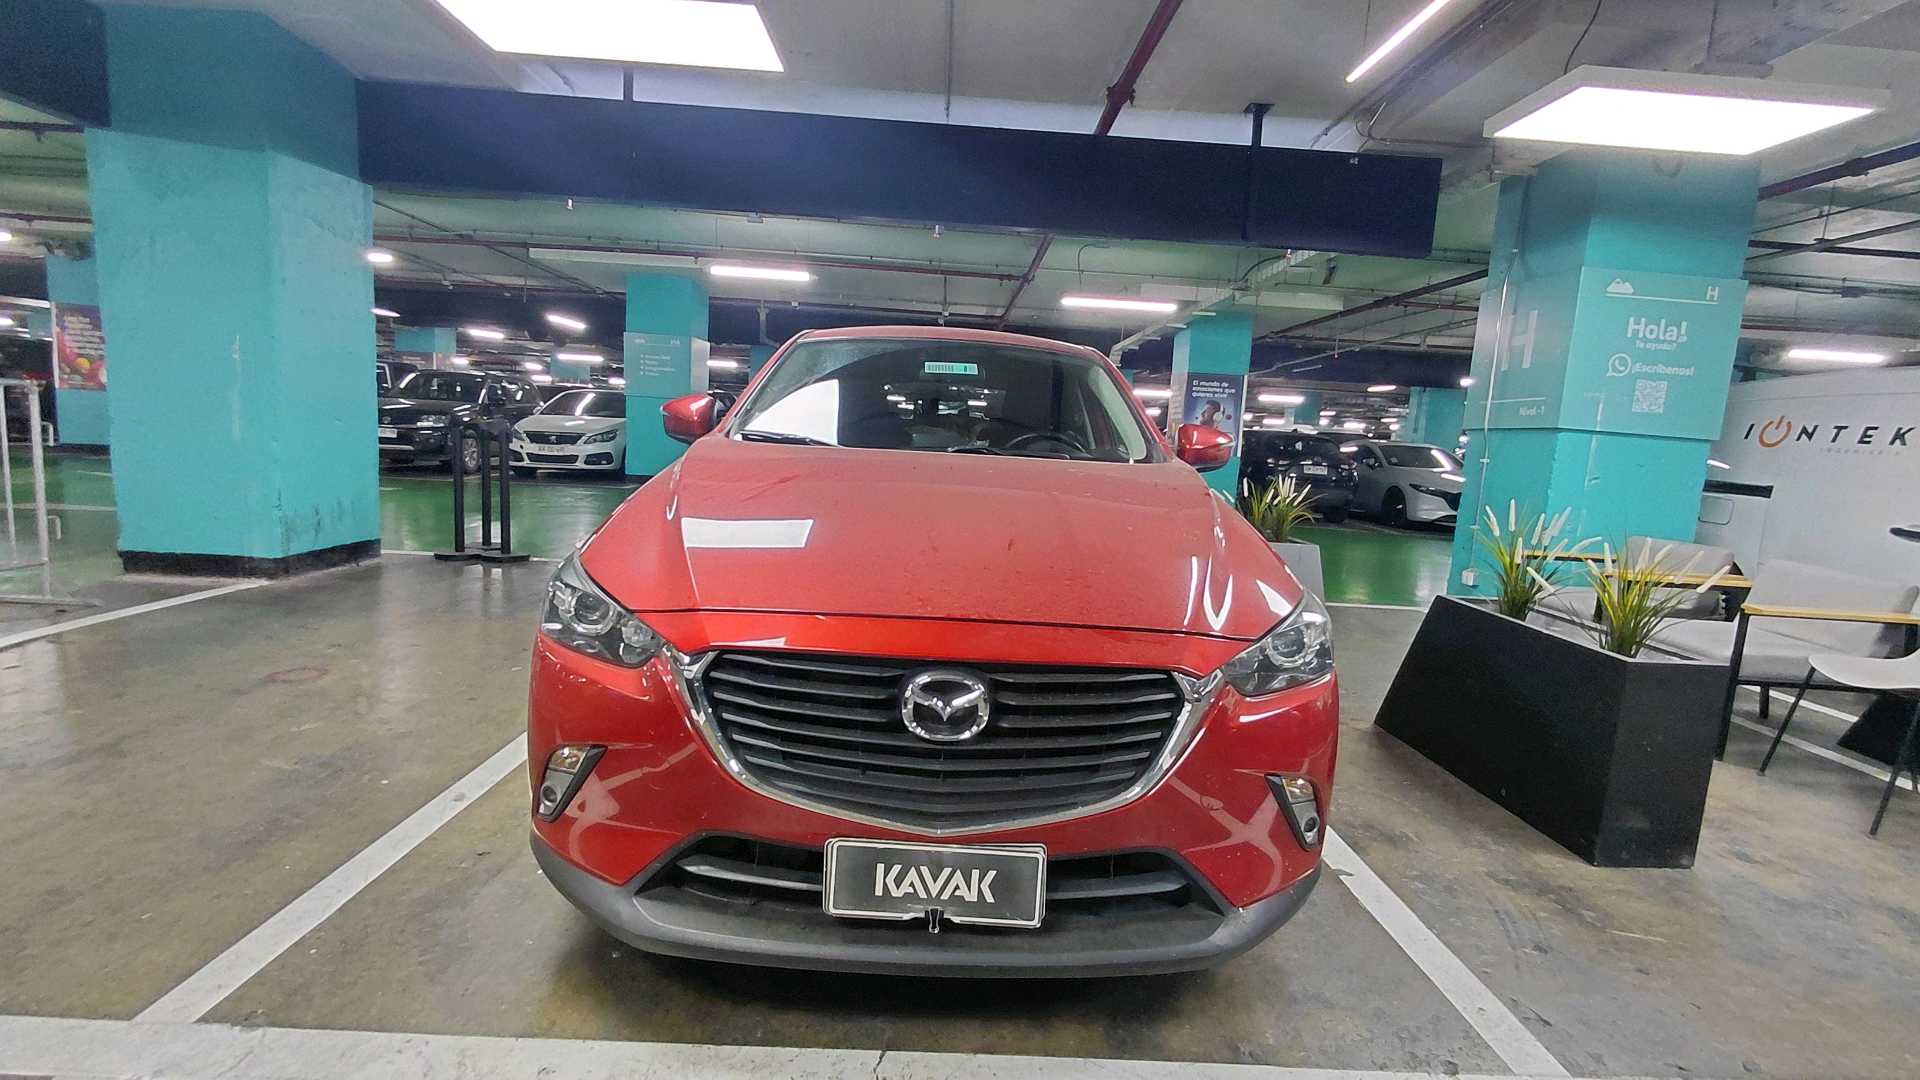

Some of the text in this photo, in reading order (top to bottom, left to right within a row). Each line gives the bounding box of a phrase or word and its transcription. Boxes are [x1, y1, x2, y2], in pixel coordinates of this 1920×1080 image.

[1706, 286, 1719, 302] H
[1626, 316, 1688, 343] Hola!
[1743, 415, 1917, 448] IONTEK
[874, 862, 998, 904] KAVAK
